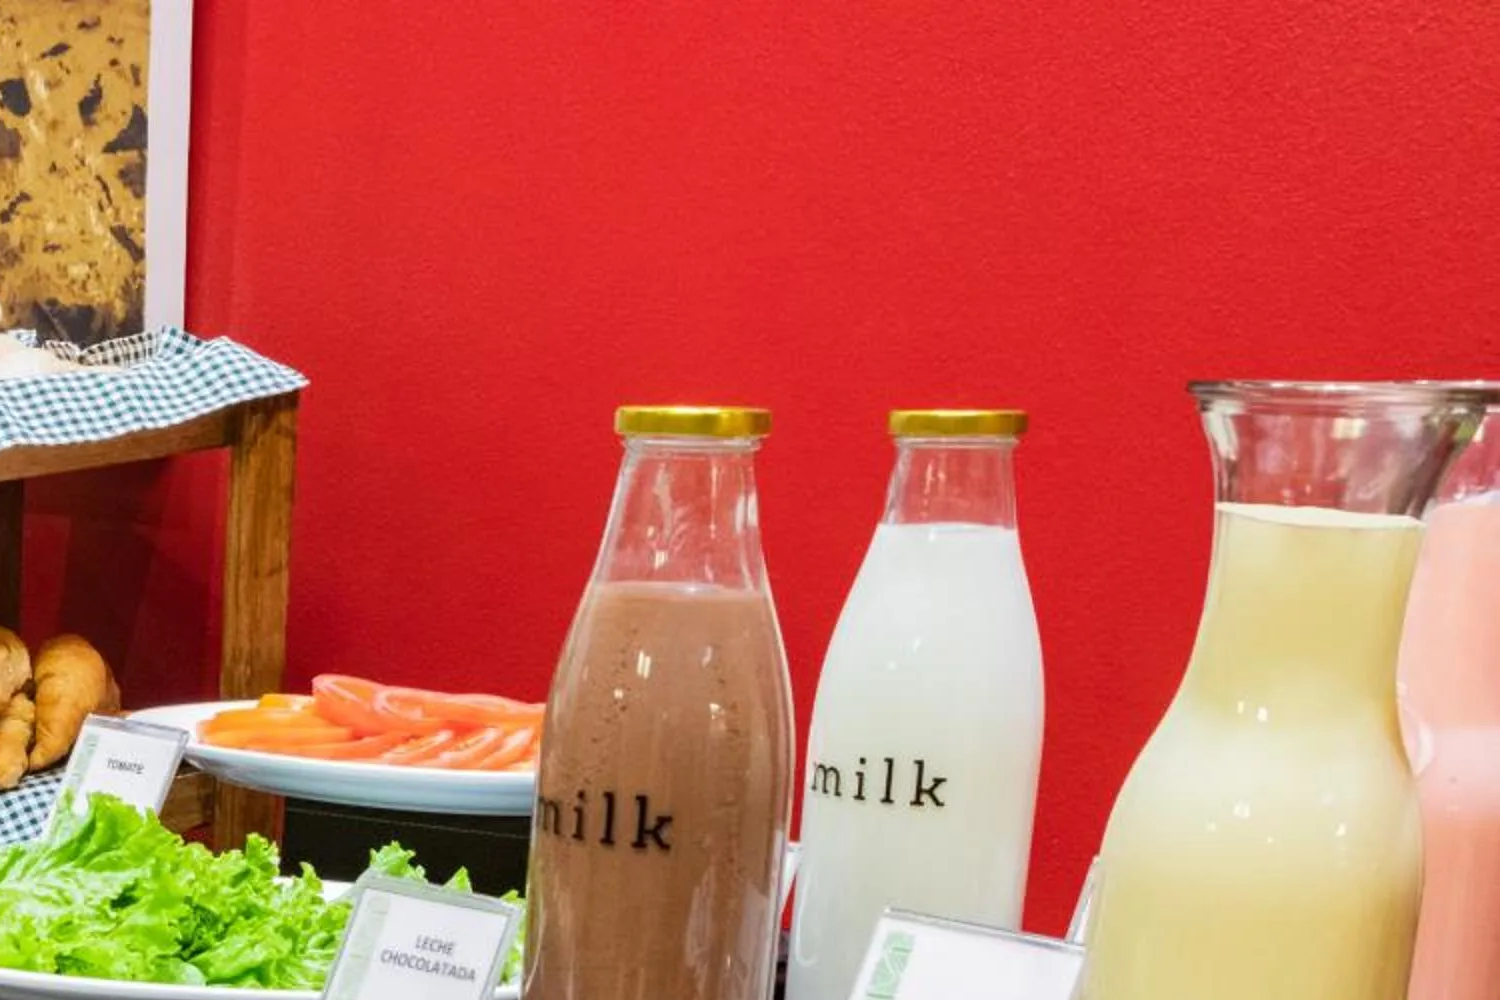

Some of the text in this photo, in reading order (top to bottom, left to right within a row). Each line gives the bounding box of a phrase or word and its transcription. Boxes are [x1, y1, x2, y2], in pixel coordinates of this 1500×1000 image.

[811, 757, 948, 808] milk
[415, 935, 456, 955] LECHE
[380, 950, 476, 982] CHOCOLATADA
